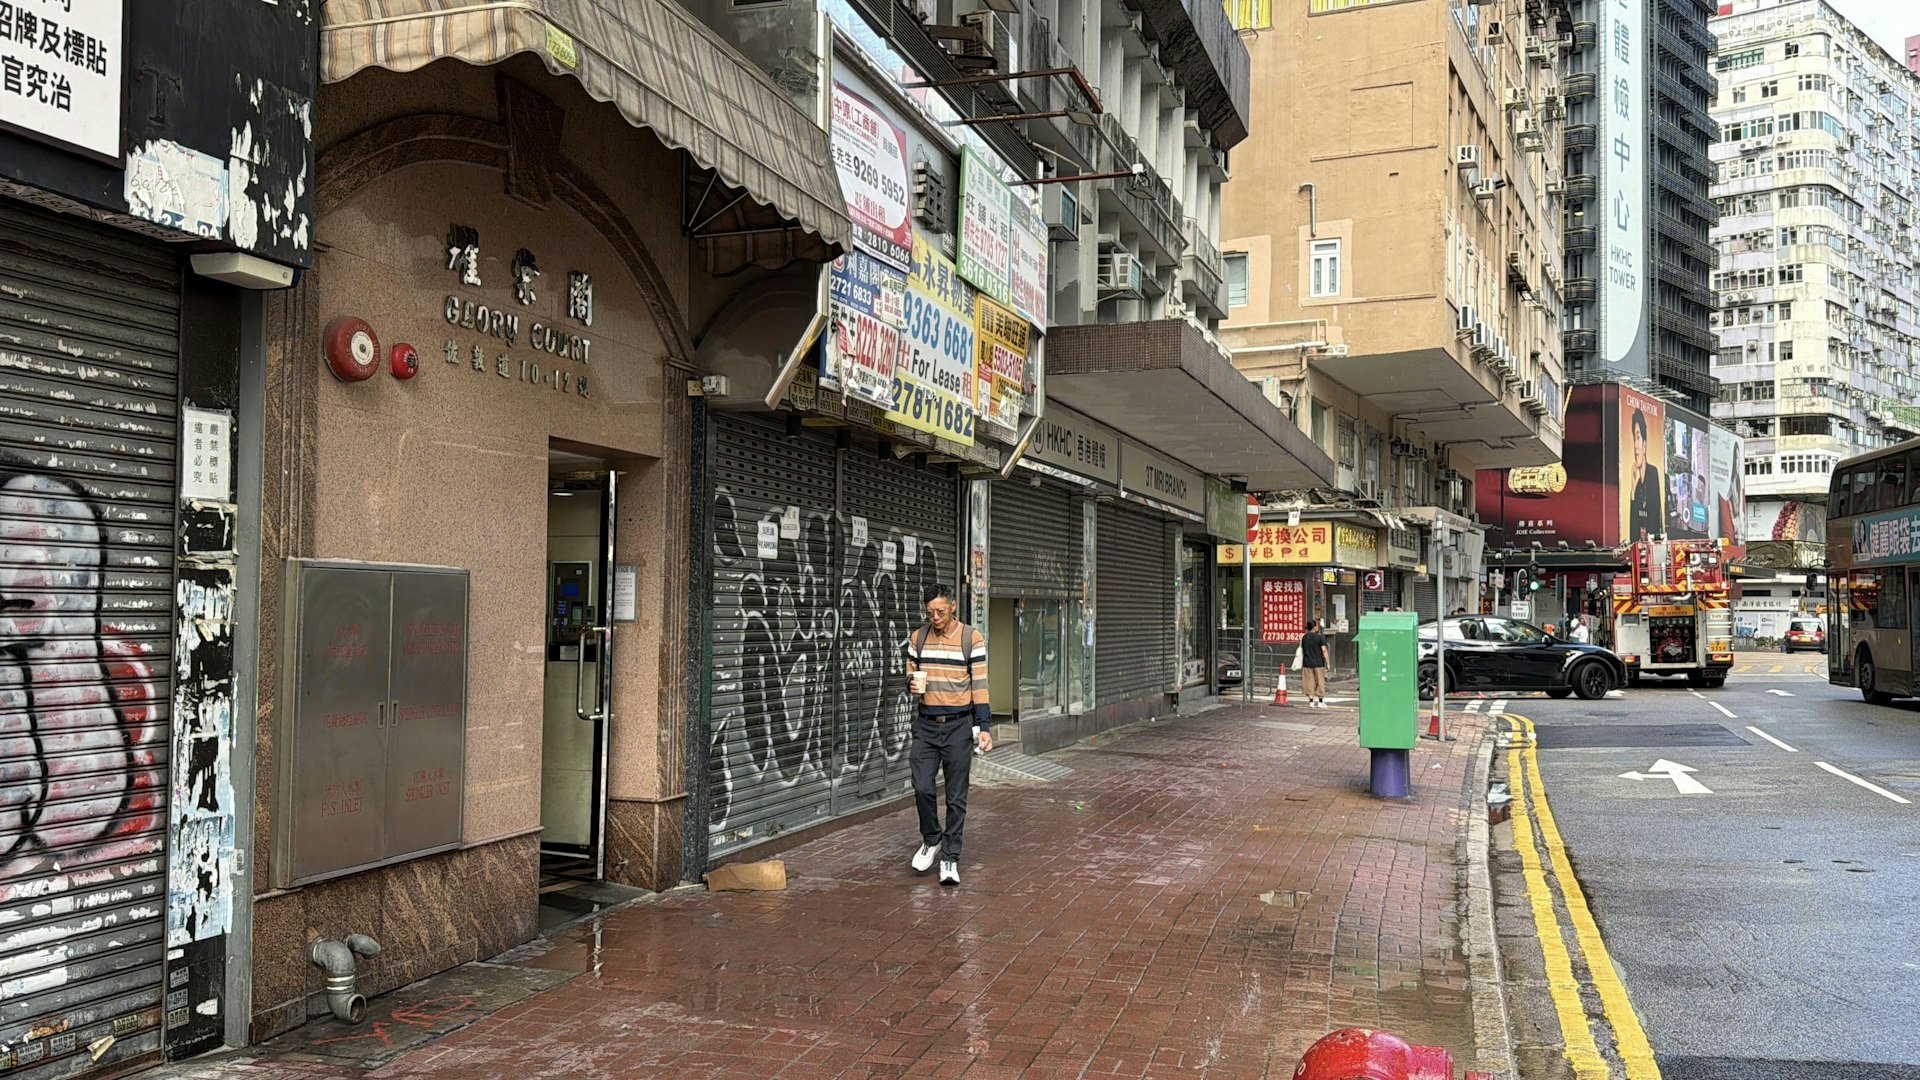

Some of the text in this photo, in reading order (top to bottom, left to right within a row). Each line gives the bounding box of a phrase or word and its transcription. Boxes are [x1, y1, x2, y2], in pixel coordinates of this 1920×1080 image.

[1, 54, 72, 113] 官究治
[1613, 0, 1631, 232] 體檢中心
[853, 155, 879, 190] 9269
[881, 173, 907, 207] 5952
[867, 231, 888, 253] 2810
[890, 244, 911, 265] 6066
[1610, 244, 1633, 268] HKHC
[830, 274, 852, 297] 2721
[852, 284, 872, 306] 6833
[923, 251, 975, 321] 永昇物業
[961, 256, 985, 289] 3616
[986, 272, 1009, 304] 0316
[1608, 266, 1636, 292] TOWER
[445, 295, 591, 365] GLORY COURT
[856, 313, 878, 370] 8228
[901, 290, 941, 350] 9363
[943, 316, 974, 369] 6681
[897, 339, 973, 400] 出 For Lease 租
[1626, 394, 1641, 409] CHOW
[1648, 404, 1659, 417] FOOK
[193, 421, 203, 484] 違者必究
[1046, 422, 1073, 458] HKHC
[1164, 472, 1188, 501] BRANCH
[1225, 547, 1235, 560] $
[1258, 527, 1327, 546] 找換公司
[1263, 580, 1304, 593] 泰安找換
